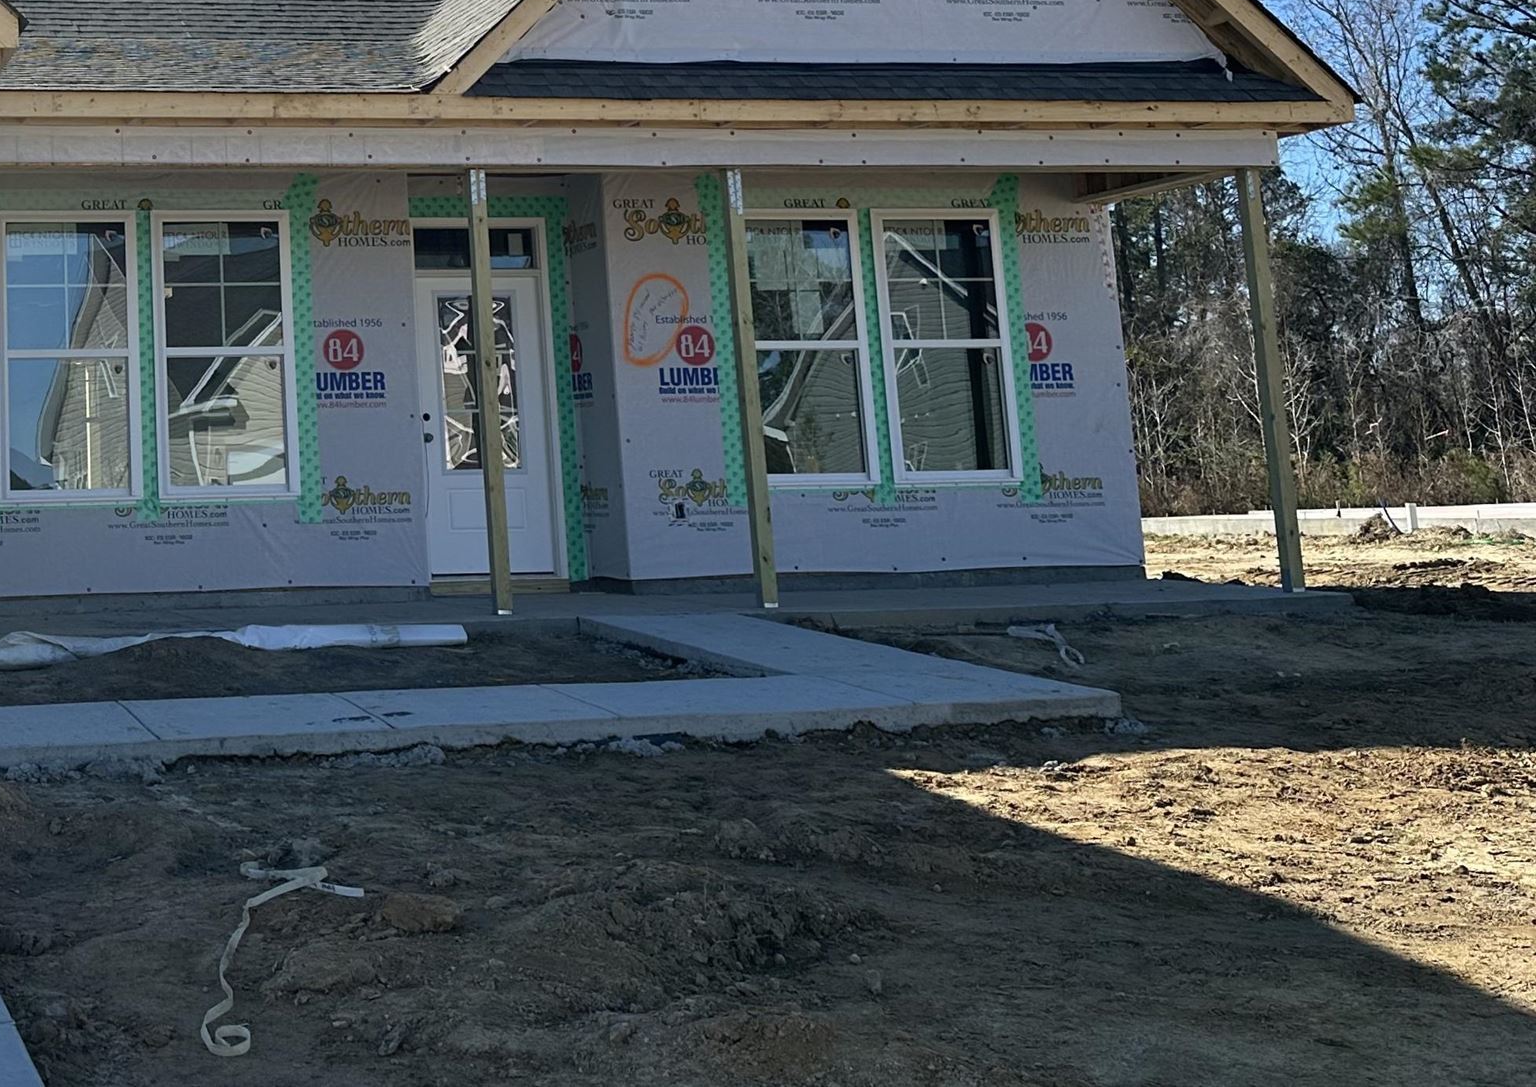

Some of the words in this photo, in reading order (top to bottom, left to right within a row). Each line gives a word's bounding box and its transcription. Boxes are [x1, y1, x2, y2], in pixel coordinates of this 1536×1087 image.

[81, 200, 127, 210] GREAT
[613, 199, 654, 209] GREAT
[784, 198, 826, 208] GREAT
[339, 237, 410, 247] HOMES.com
[1023, 234, 1090, 244] HOMES.com
[1047, 312, 1067, 320] 1956
[313, 319, 356, 327] tablished
[360, 319, 382, 327] 1956
[329, 338, 359, 362] 84
[681, 335, 710, 357] 84
[316, 372, 385, 392] UMBER
[659, 368, 719, 386] LUMB
[650, 470, 683, 478] GREAT
